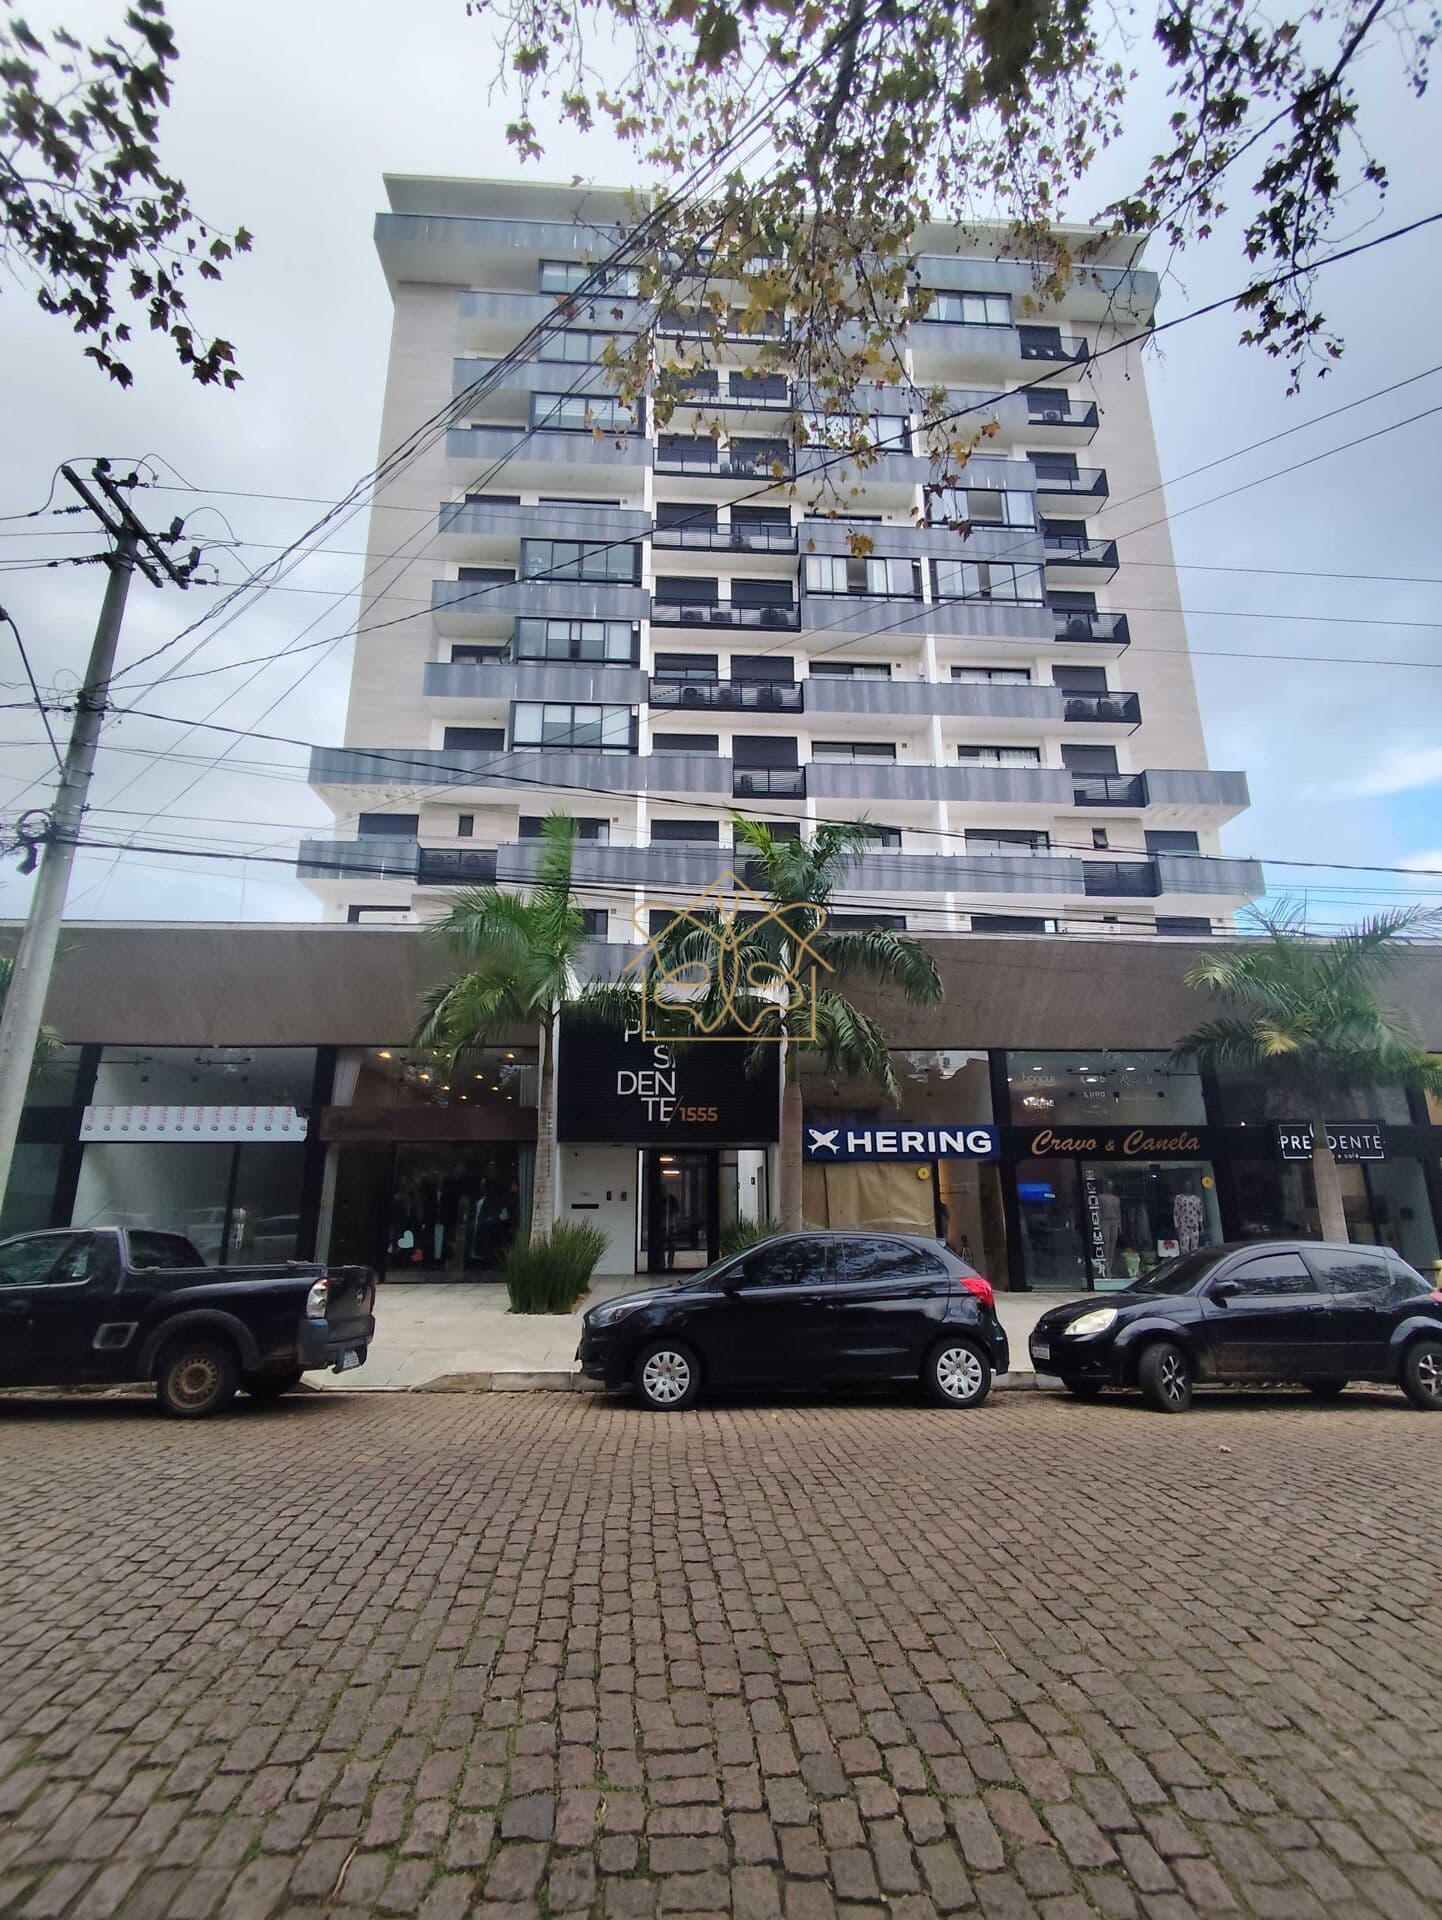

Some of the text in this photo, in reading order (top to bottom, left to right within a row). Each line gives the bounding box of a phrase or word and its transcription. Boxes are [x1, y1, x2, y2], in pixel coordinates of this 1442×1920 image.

[617, 1071, 676, 1095] DEN
[847, 1131, 992, 1153] HERING
[1031, 1129, 1200, 1155] Cravo & Canela
[1280, 1135, 1383, 1150] PREDENTE
